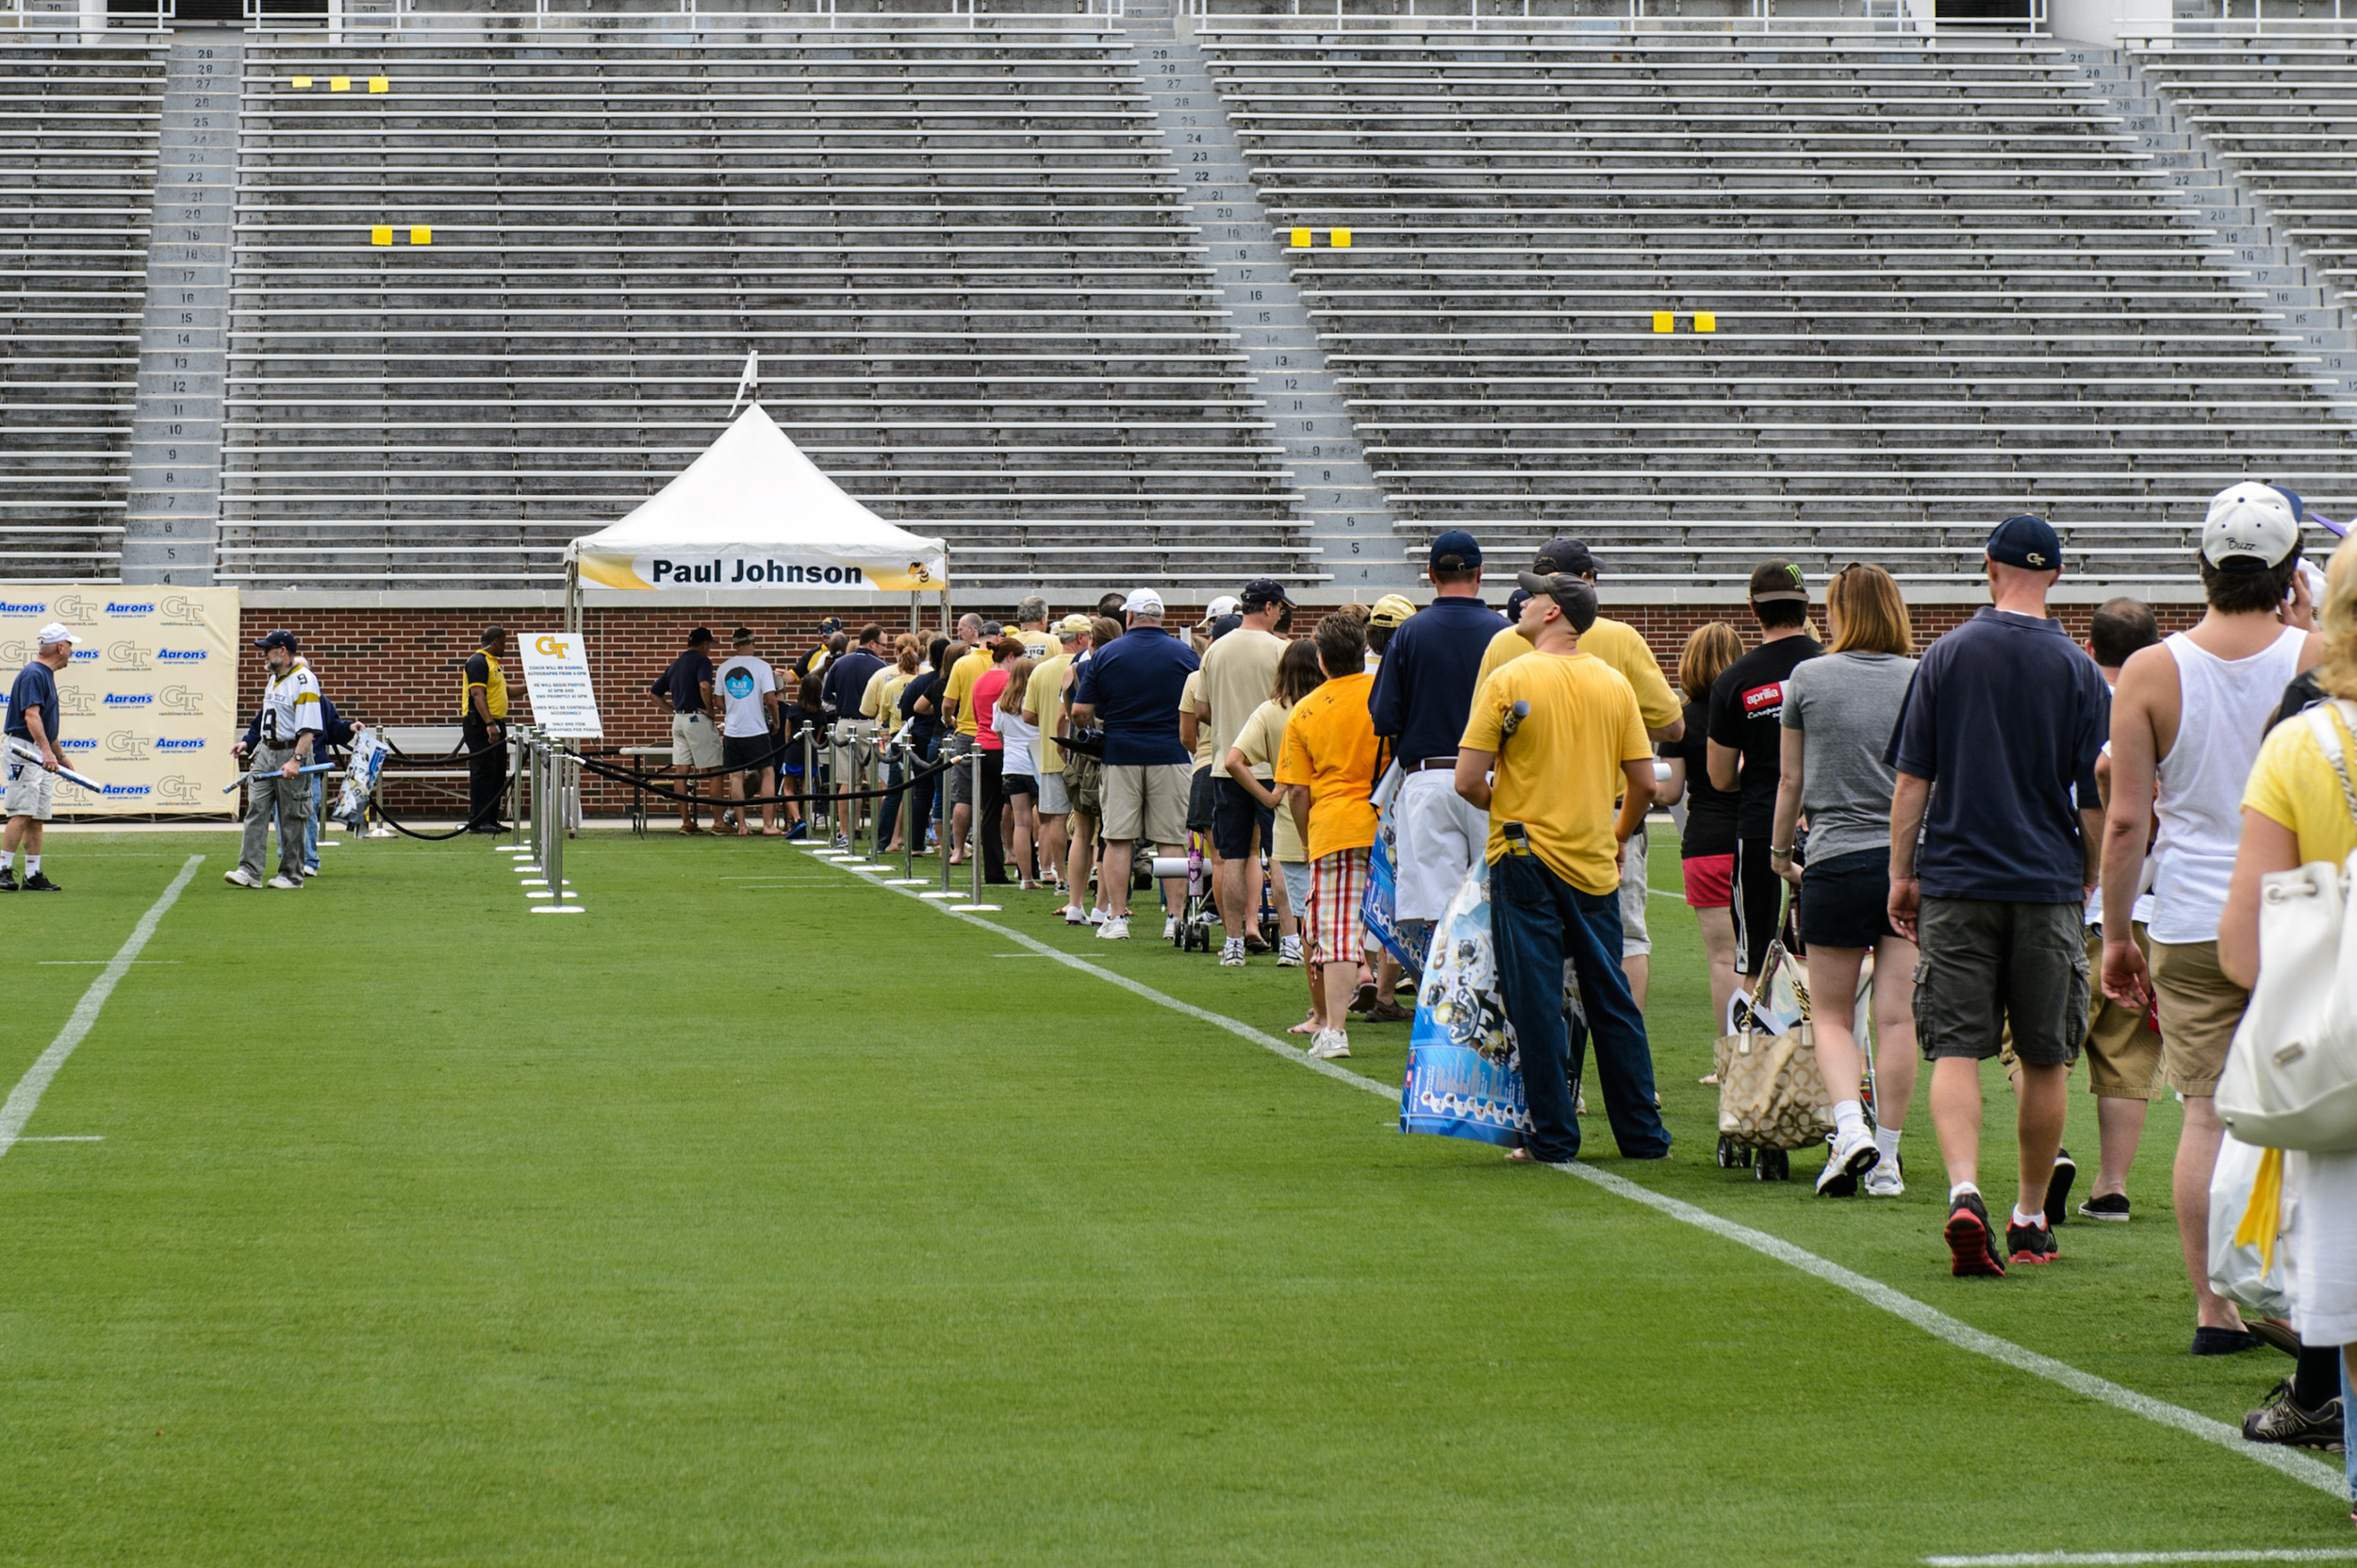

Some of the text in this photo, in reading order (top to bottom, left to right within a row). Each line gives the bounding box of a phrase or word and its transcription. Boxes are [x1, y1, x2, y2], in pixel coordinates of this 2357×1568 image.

[198, 50, 214, 59] 29
[1152, 50, 1167, 59] 29
[2070, 53, 2085, 63] 29
[198, 64, 213, 74] 28
[1161, 64, 1176, 74] 28
[196, 79, 211, 89] 27
[1166, 79, 1181, 89] 27
[2100, 84, 2115, 94] 27
[194, 98, 209, 108] 26
[1174, 97, 1189, 107] 26
[193, 117, 208, 127] 25
[2130, 120, 2145, 130] 25
[1187, 133, 1202, 143] 24
[189, 153, 204, 163] 23
[1192, 152, 1208, 162] 23
[187, 172, 203, 182] 22
[1195, 172, 1209, 182] 22
[2175, 176, 2190, 185] 22
[190, 192, 203, 202] 21
[1211, 190, 1224, 201] 21
[184, 209, 201, 219] 20
[1217, 208, 1233, 218] 20
[2210, 211, 2225, 221] 20
[187, 231, 200, 240] 19
[2225, 233, 2238, 243] 19
[2242, 250, 2254, 261] 18
[182, 272, 195, 282] 17
[1240, 270, 1253, 280] 17
[2257, 271, 2269, 281] 17
[181, 293, 194, 303] 16
[1250, 290, 1262, 301] 16
[2276, 292, 2289, 302] 16
[181, 313, 193, 323] 15
[1259, 312, 1271, 323] 15
[2295, 314, 2306, 323] 15
[177, 334, 190, 345] 14
[2310, 335, 2321, 345] 14
[174, 358, 188, 369] 13
[1275, 355, 1287, 366] 13
[2329, 358, 2341, 368] 13
[173, 381, 186, 392] 12
[1285, 379, 1298, 390] 12
[174, 404, 184, 415] 11
[1294, 400, 1303, 411] 11
[169, 424, 182, 435] 10
[1301, 421, 1313, 431] 10
[168, 449, 177, 461] 9
[1312, 446, 1320, 457] 9
[165, 472, 174, 483] 8
[1323, 470, 1331, 481] 8
[167, 496, 175, 508] 7
[1334, 493, 1342, 504] 7
[165, 522, 173, 533] 6
[1346, 517, 1355, 528] 6
[1352, 543, 1360, 554] 5
[2225, 537, 2256, 550] Buzz
[167, 548, 176, 560] 5
[2027, 553, 2046, 566] GT
[653, 559, 862, 584] Paul Johnson
[163, 573, 171, 585] 4
[54, 595, 97, 621] GT
[106, 602, 154, 612] Aaron's
[161, 596, 204, 621] GT
[536, 636, 569, 659] GT
[70, 649, 99, 659] ron's
[107, 641, 151, 667] GT
[157, 649, 207, 659] Aaron's
[297, 673, 308, 685] 9
[104, 694, 153, 703] Aaron's
[159, 685, 203, 711] GT
[1747, 688, 1779, 705] aprilia
[263, 708, 277, 741] 9
[60, 740, 97, 748] aron's
[106, 731, 149, 756] GT
[156, 738, 205, 748] Aaron's
[102, 784, 150, 794] Aaron's
[157, 775, 201, 801] GT
